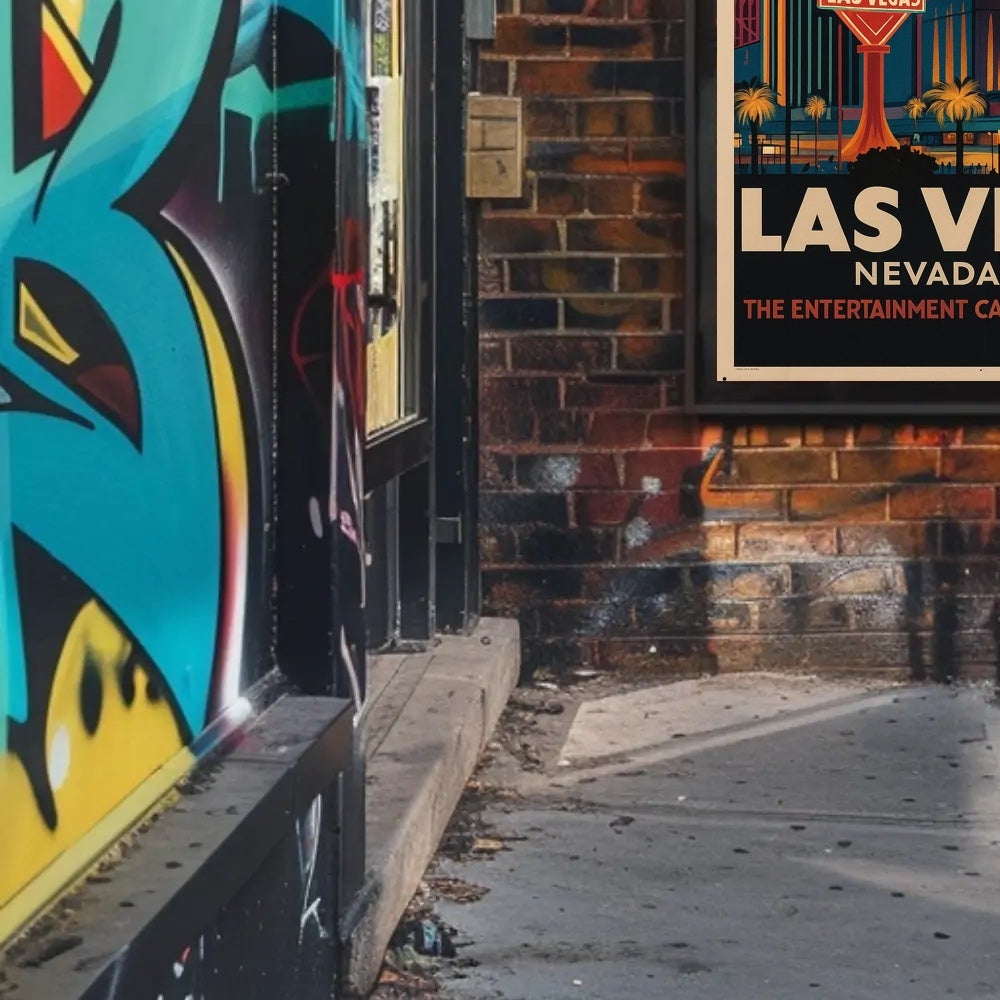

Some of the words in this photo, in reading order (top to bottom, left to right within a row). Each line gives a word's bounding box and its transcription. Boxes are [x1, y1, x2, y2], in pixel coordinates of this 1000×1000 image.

[742, 186, 902, 253] LAS
[743, 299, 785, 320] THE
[791, 299, 969, 320] ENTERTAINMENT
